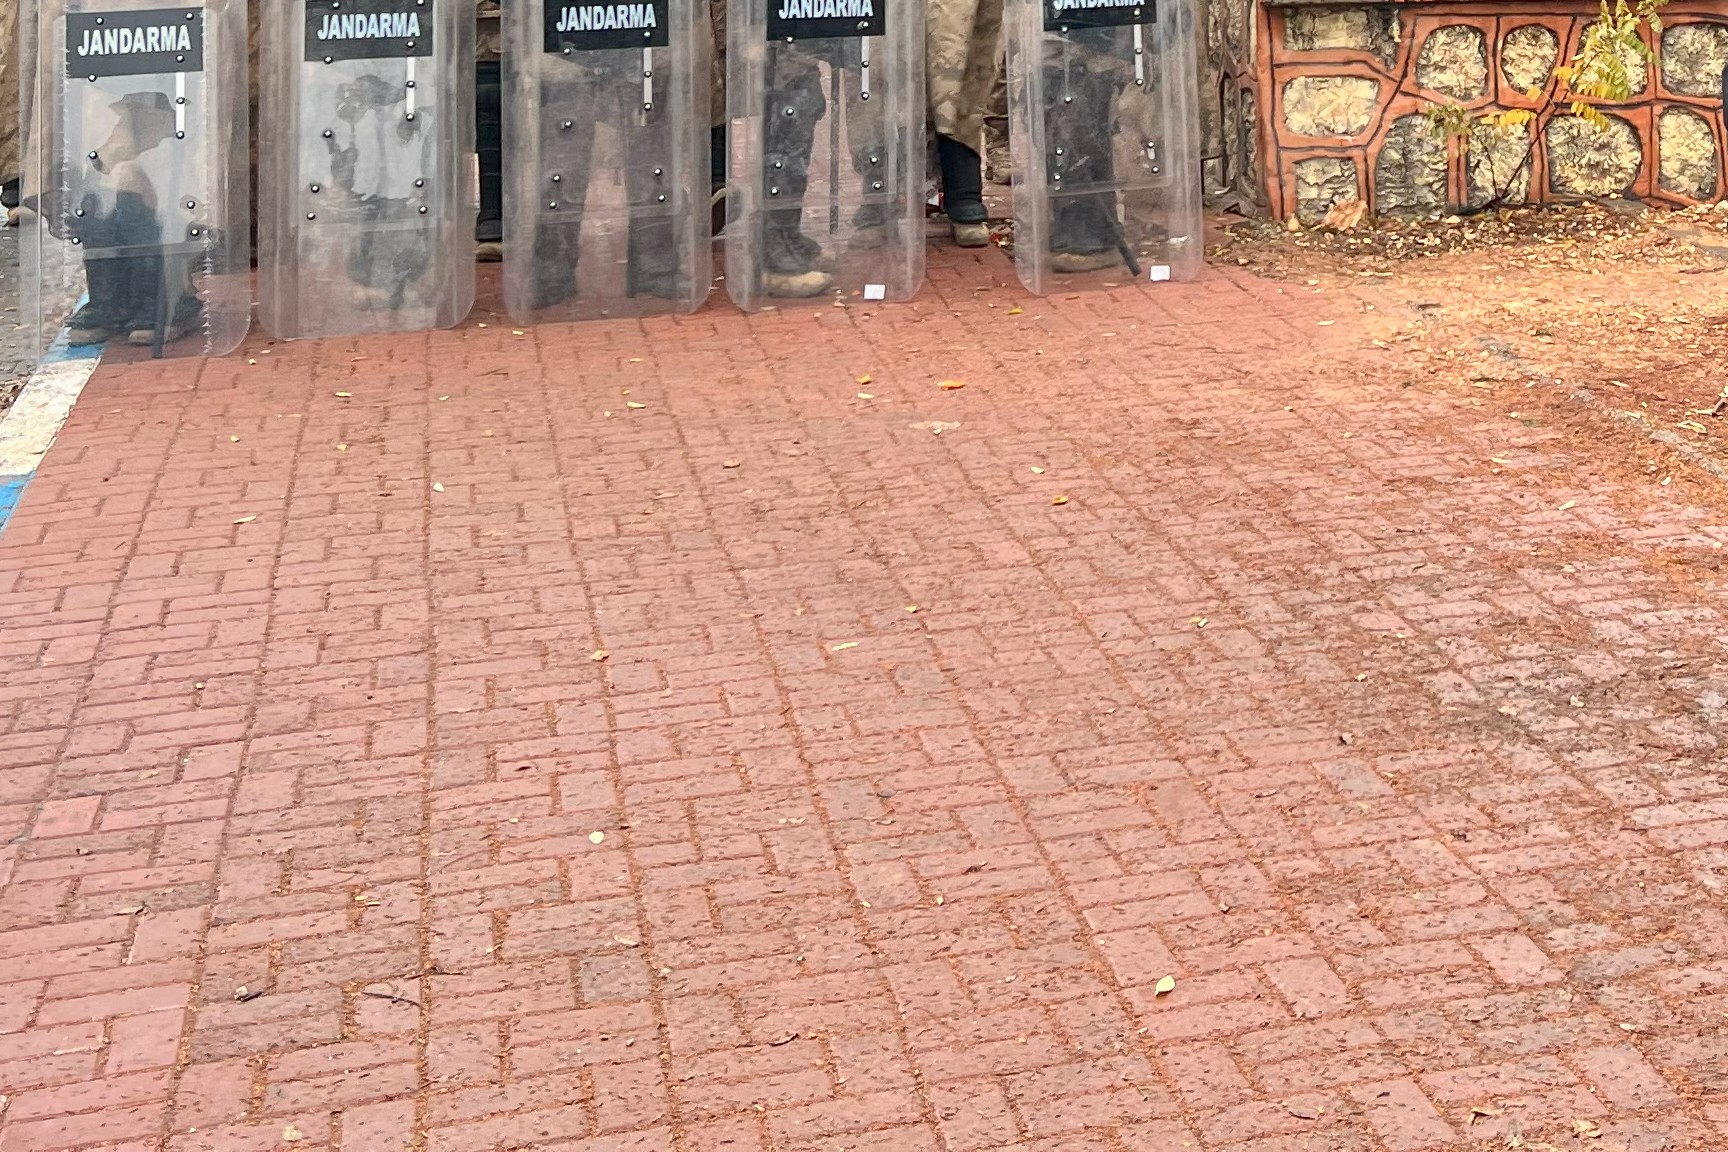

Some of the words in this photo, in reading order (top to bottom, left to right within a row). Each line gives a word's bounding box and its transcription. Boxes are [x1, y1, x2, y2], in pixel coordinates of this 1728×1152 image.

[317, 12, 421, 40] JANDARMA
[556, 4, 657, 32] JANDARMA
[77, 25, 192, 57] JANDARMA
